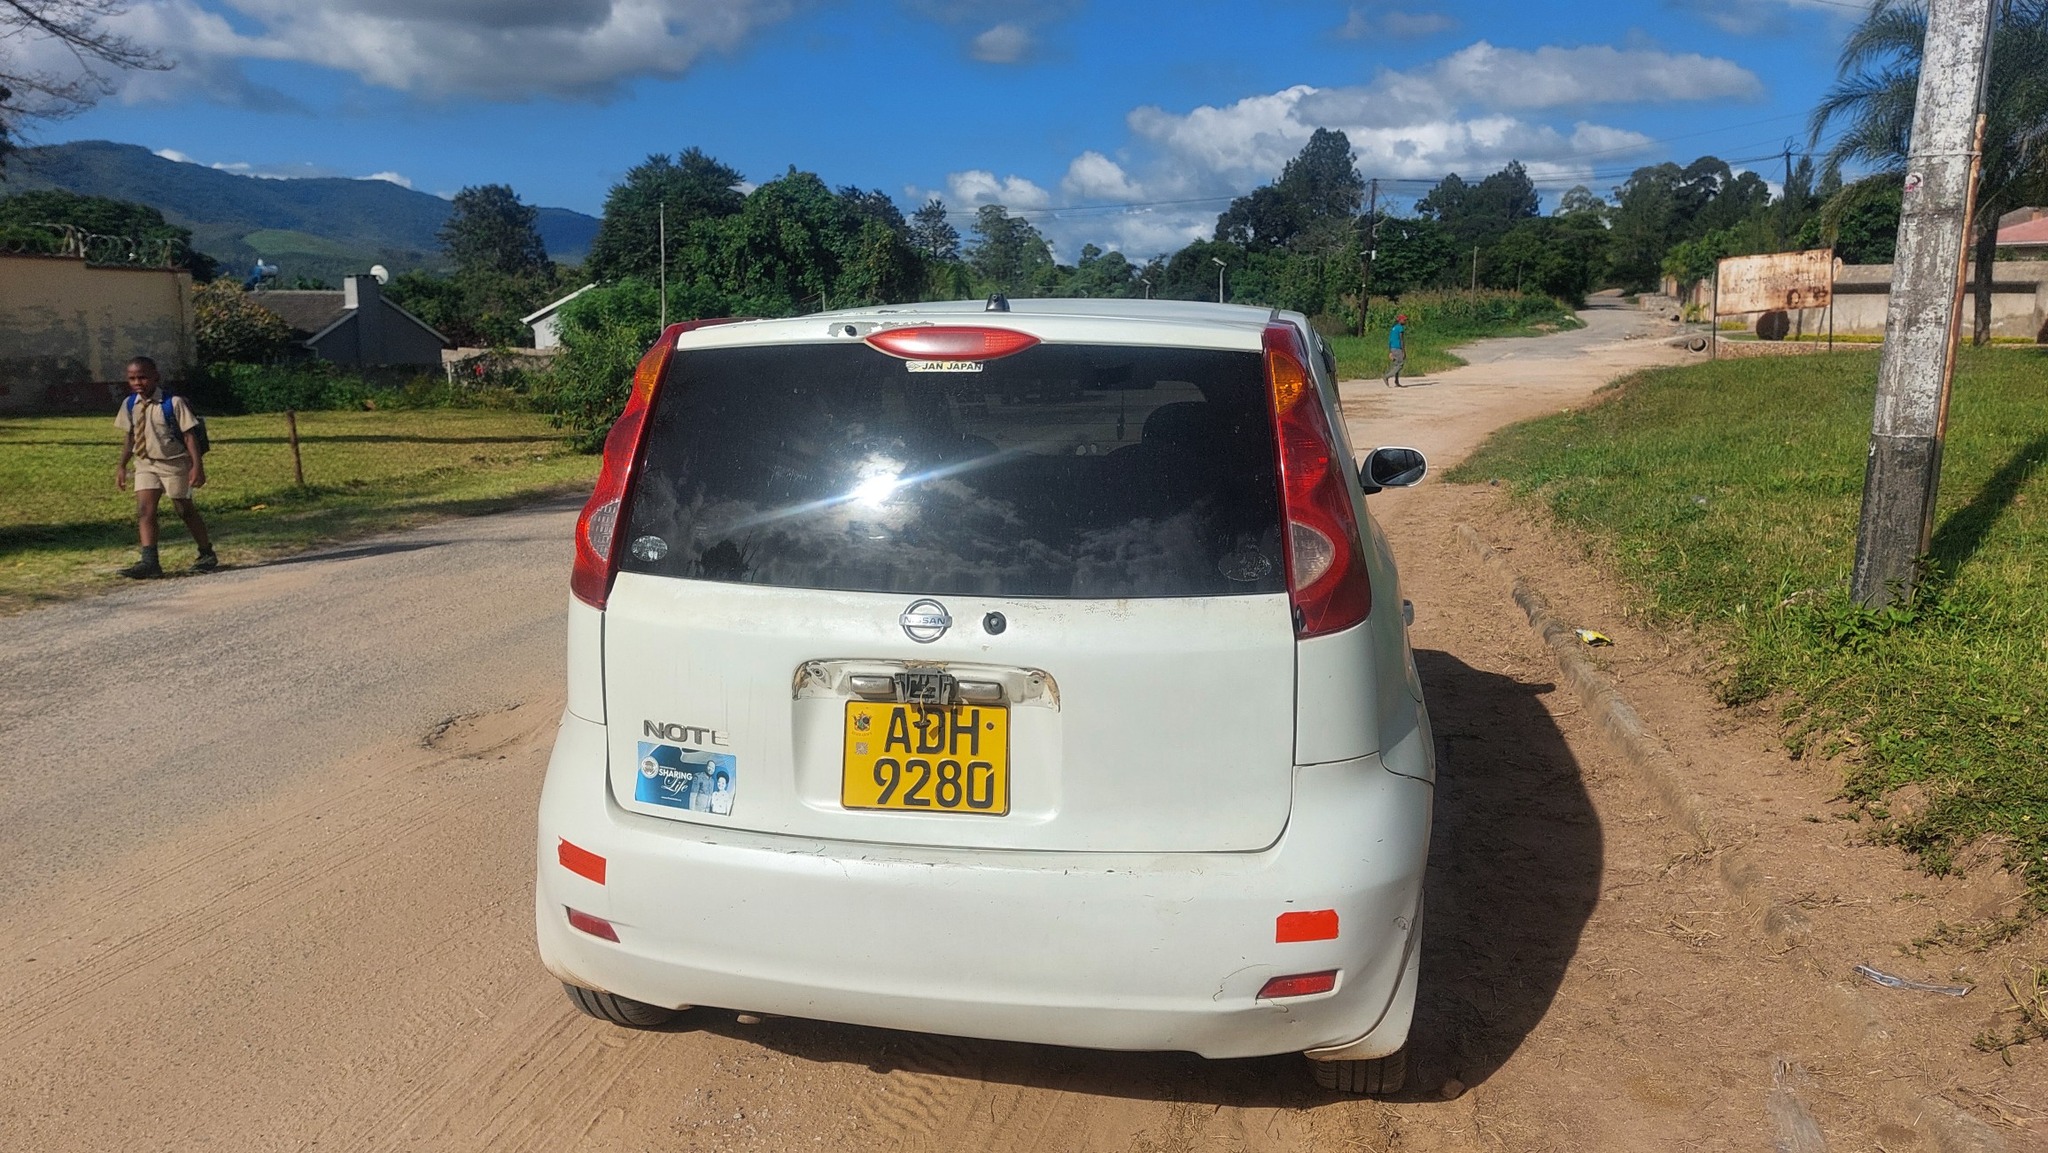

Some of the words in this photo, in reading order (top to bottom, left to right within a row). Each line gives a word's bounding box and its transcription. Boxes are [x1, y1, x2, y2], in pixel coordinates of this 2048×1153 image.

[922, 362, 943, 370] JAN
[946, 362, 981, 371] JAPAN
[903, 615, 946, 625] NSSAN
[643, 719, 730, 747] NOTE
[883, 706, 980, 756] ADH
[658, 768, 693, 781] SHARING
[872, 758, 995, 809] 9280
[660, 775, 689, 796] Life
